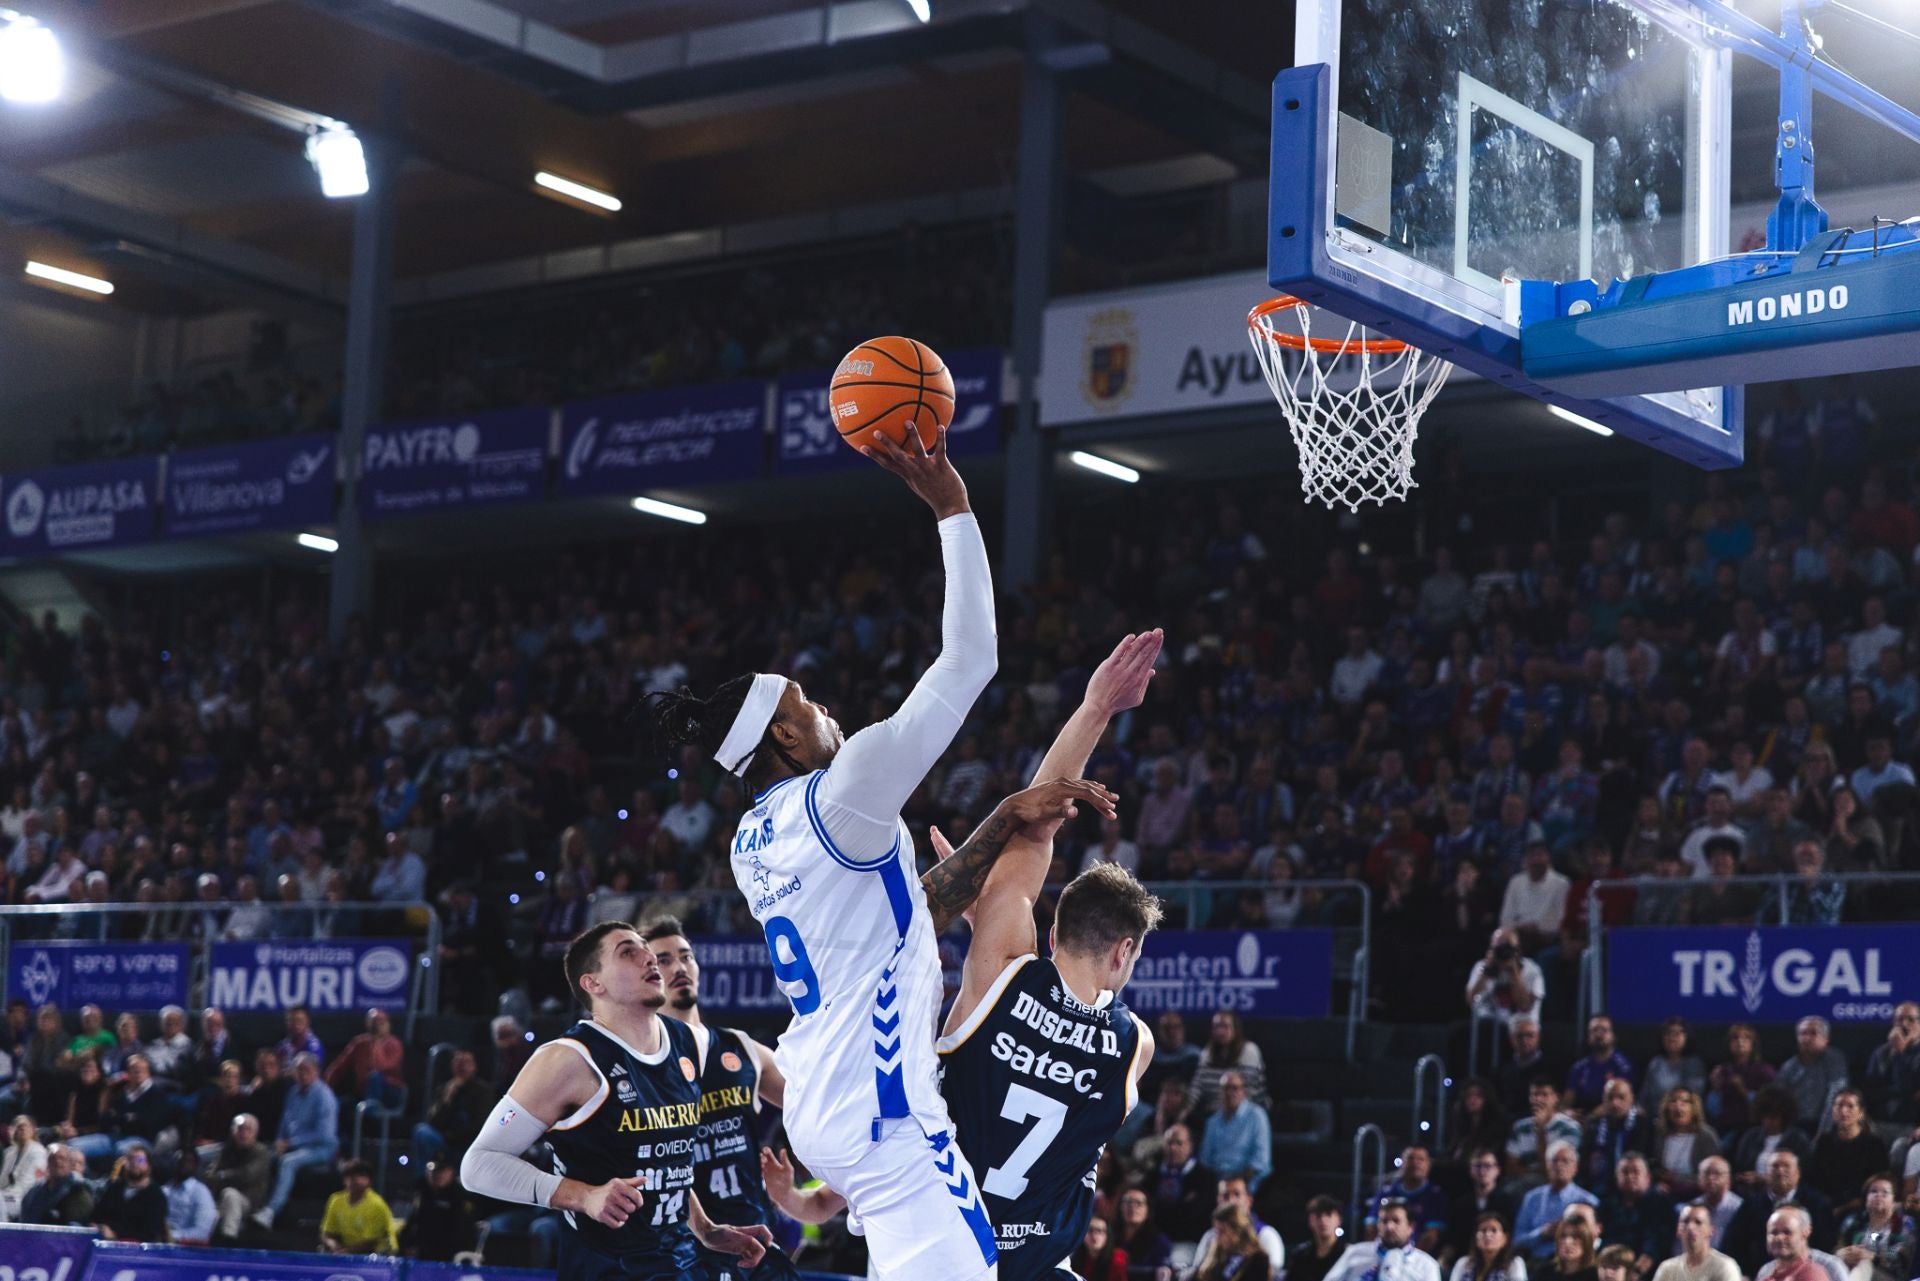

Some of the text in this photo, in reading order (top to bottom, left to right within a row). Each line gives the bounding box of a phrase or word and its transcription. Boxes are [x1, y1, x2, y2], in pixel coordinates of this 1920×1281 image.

[1728, 284, 1849, 326] MONDO
[839, 406, 859, 419] FEB
[47, 480, 146, 515] AUPASA
[775, 875, 801, 901] salud
[72, 953, 179, 974] sara varas
[764, 915, 820, 1016] 9
[212, 966, 354, 1009] MAURI
[1833, 1003, 1893, 1019] GRUPO
[1100, 1029, 1122, 1058] D.
[990, 1032, 1098, 1094] satec
[618, 1090, 637, 1099] OVIEDO
[697, 1116, 742, 1138] OVIEDO
[982, 1082, 1068, 1200] 7
[709, 1164, 742, 1199] 41
[651, 1189, 684, 1225] 14
